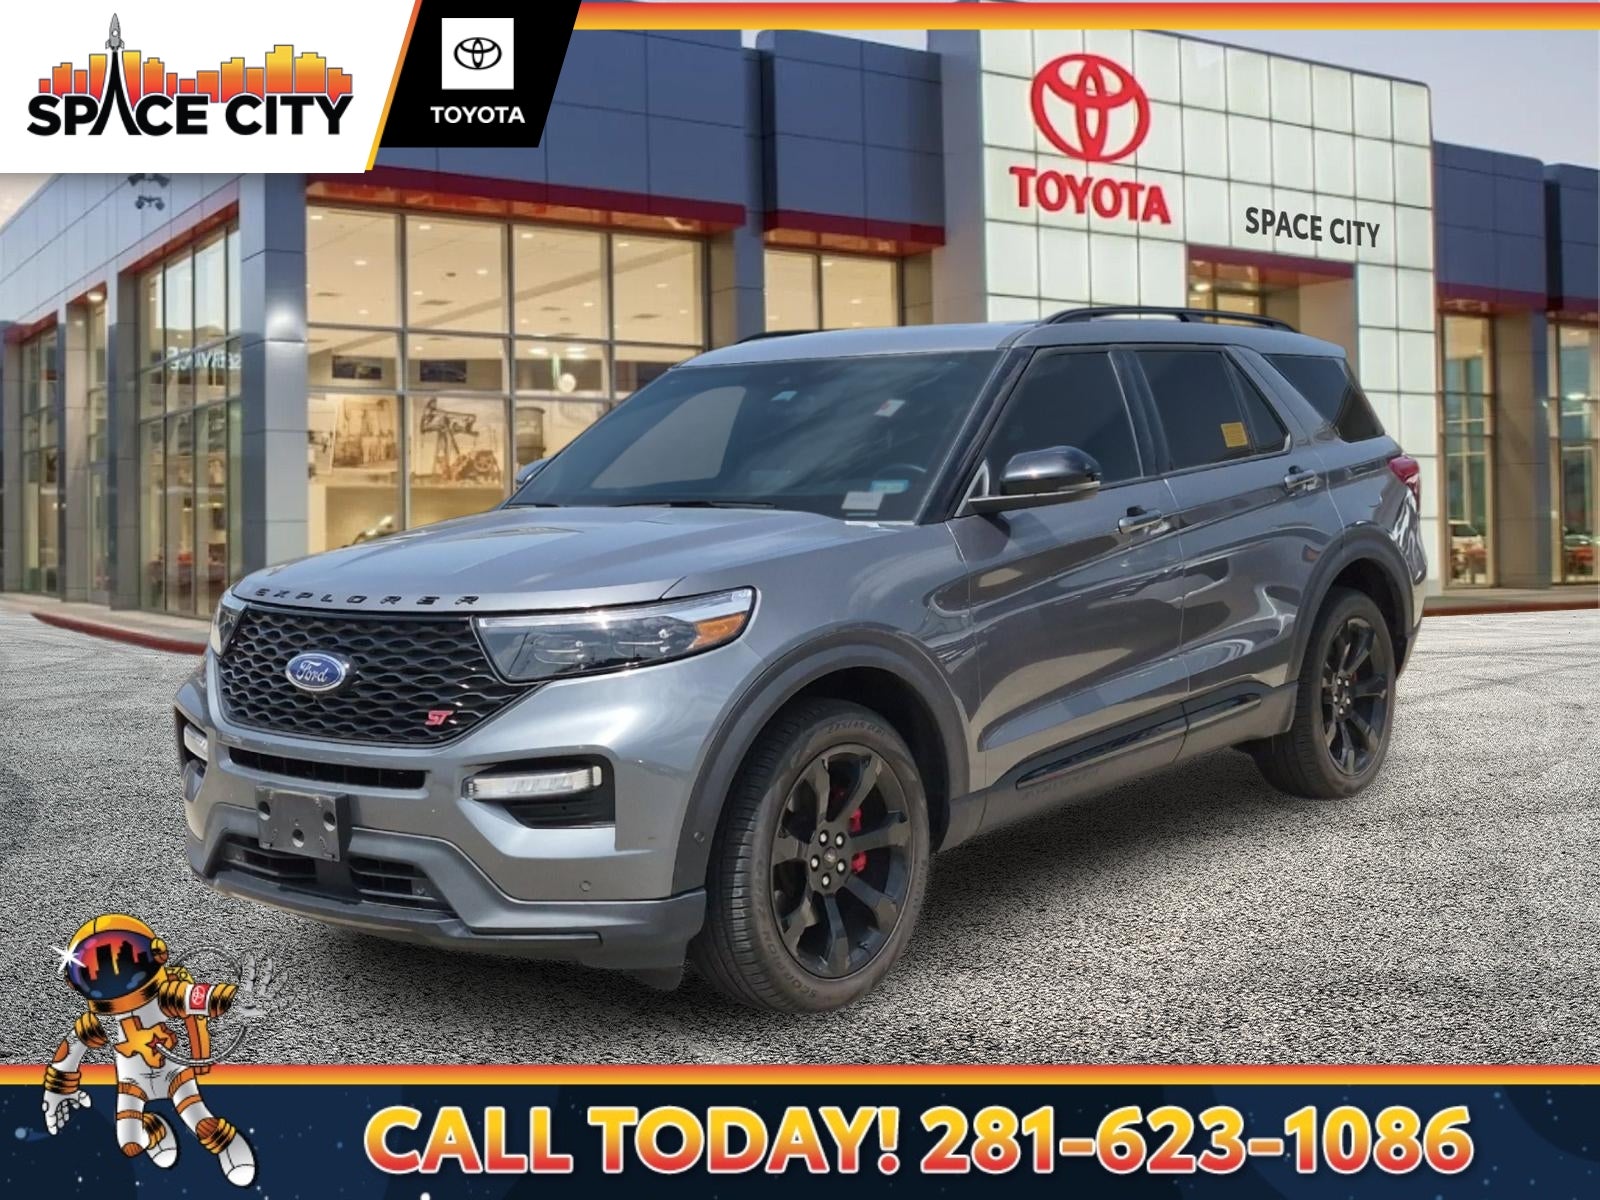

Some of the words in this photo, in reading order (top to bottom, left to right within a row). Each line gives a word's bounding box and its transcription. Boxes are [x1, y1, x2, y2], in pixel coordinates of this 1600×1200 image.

[1010, 166, 1171, 224] TOYOTA
[1245, 206, 1323, 242] SPACE
[1329, 218, 1381, 248] CITY
[255, 588, 480, 606] EXPLORER
[296, 660, 329, 682] Ford
[425, 710, 454, 725] ST
